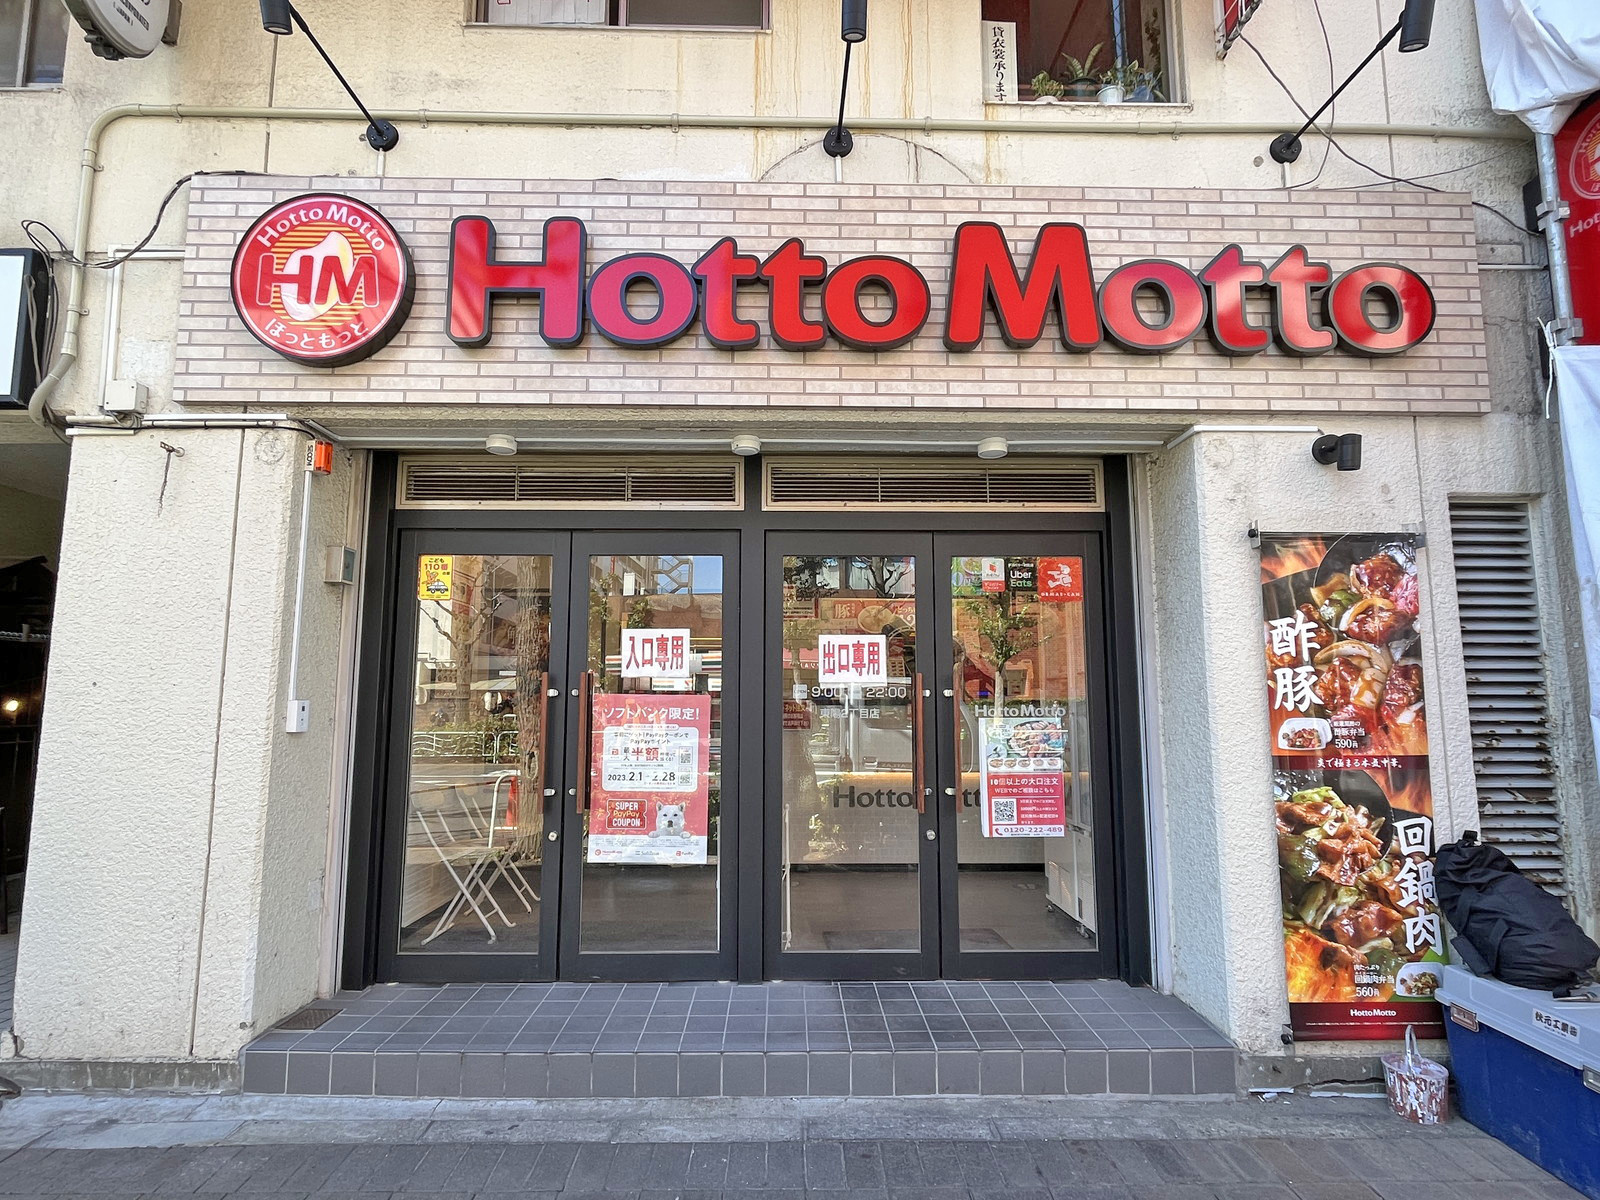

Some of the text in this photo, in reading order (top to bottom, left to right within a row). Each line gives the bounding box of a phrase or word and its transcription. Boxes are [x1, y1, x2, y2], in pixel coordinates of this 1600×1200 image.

[265, 318, 368, 350] ほっともっと
[1010, 570, 1032, 579] Uber
[1010, 579, 1032, 587] Eats
[626, 634, 684, 671] 入口専用
[823, 640, 880, 676] 出口専用
[1268, 611, 1324, 712] 酢豚
[866, 686, 907, 698] 22:00
[1335, 739, 1359, 749] 590円
[615, 802, 639, 810] SUPER
[613, 810, 640, 818] PayPay
[612, 818, 640, 827] COUPON
[1392, 815, 1444, 954] 回鍋肉
[1355, 974, 1394, 984] 回鍋肉弁当
[1356, 986, 1380, 997] 560円
